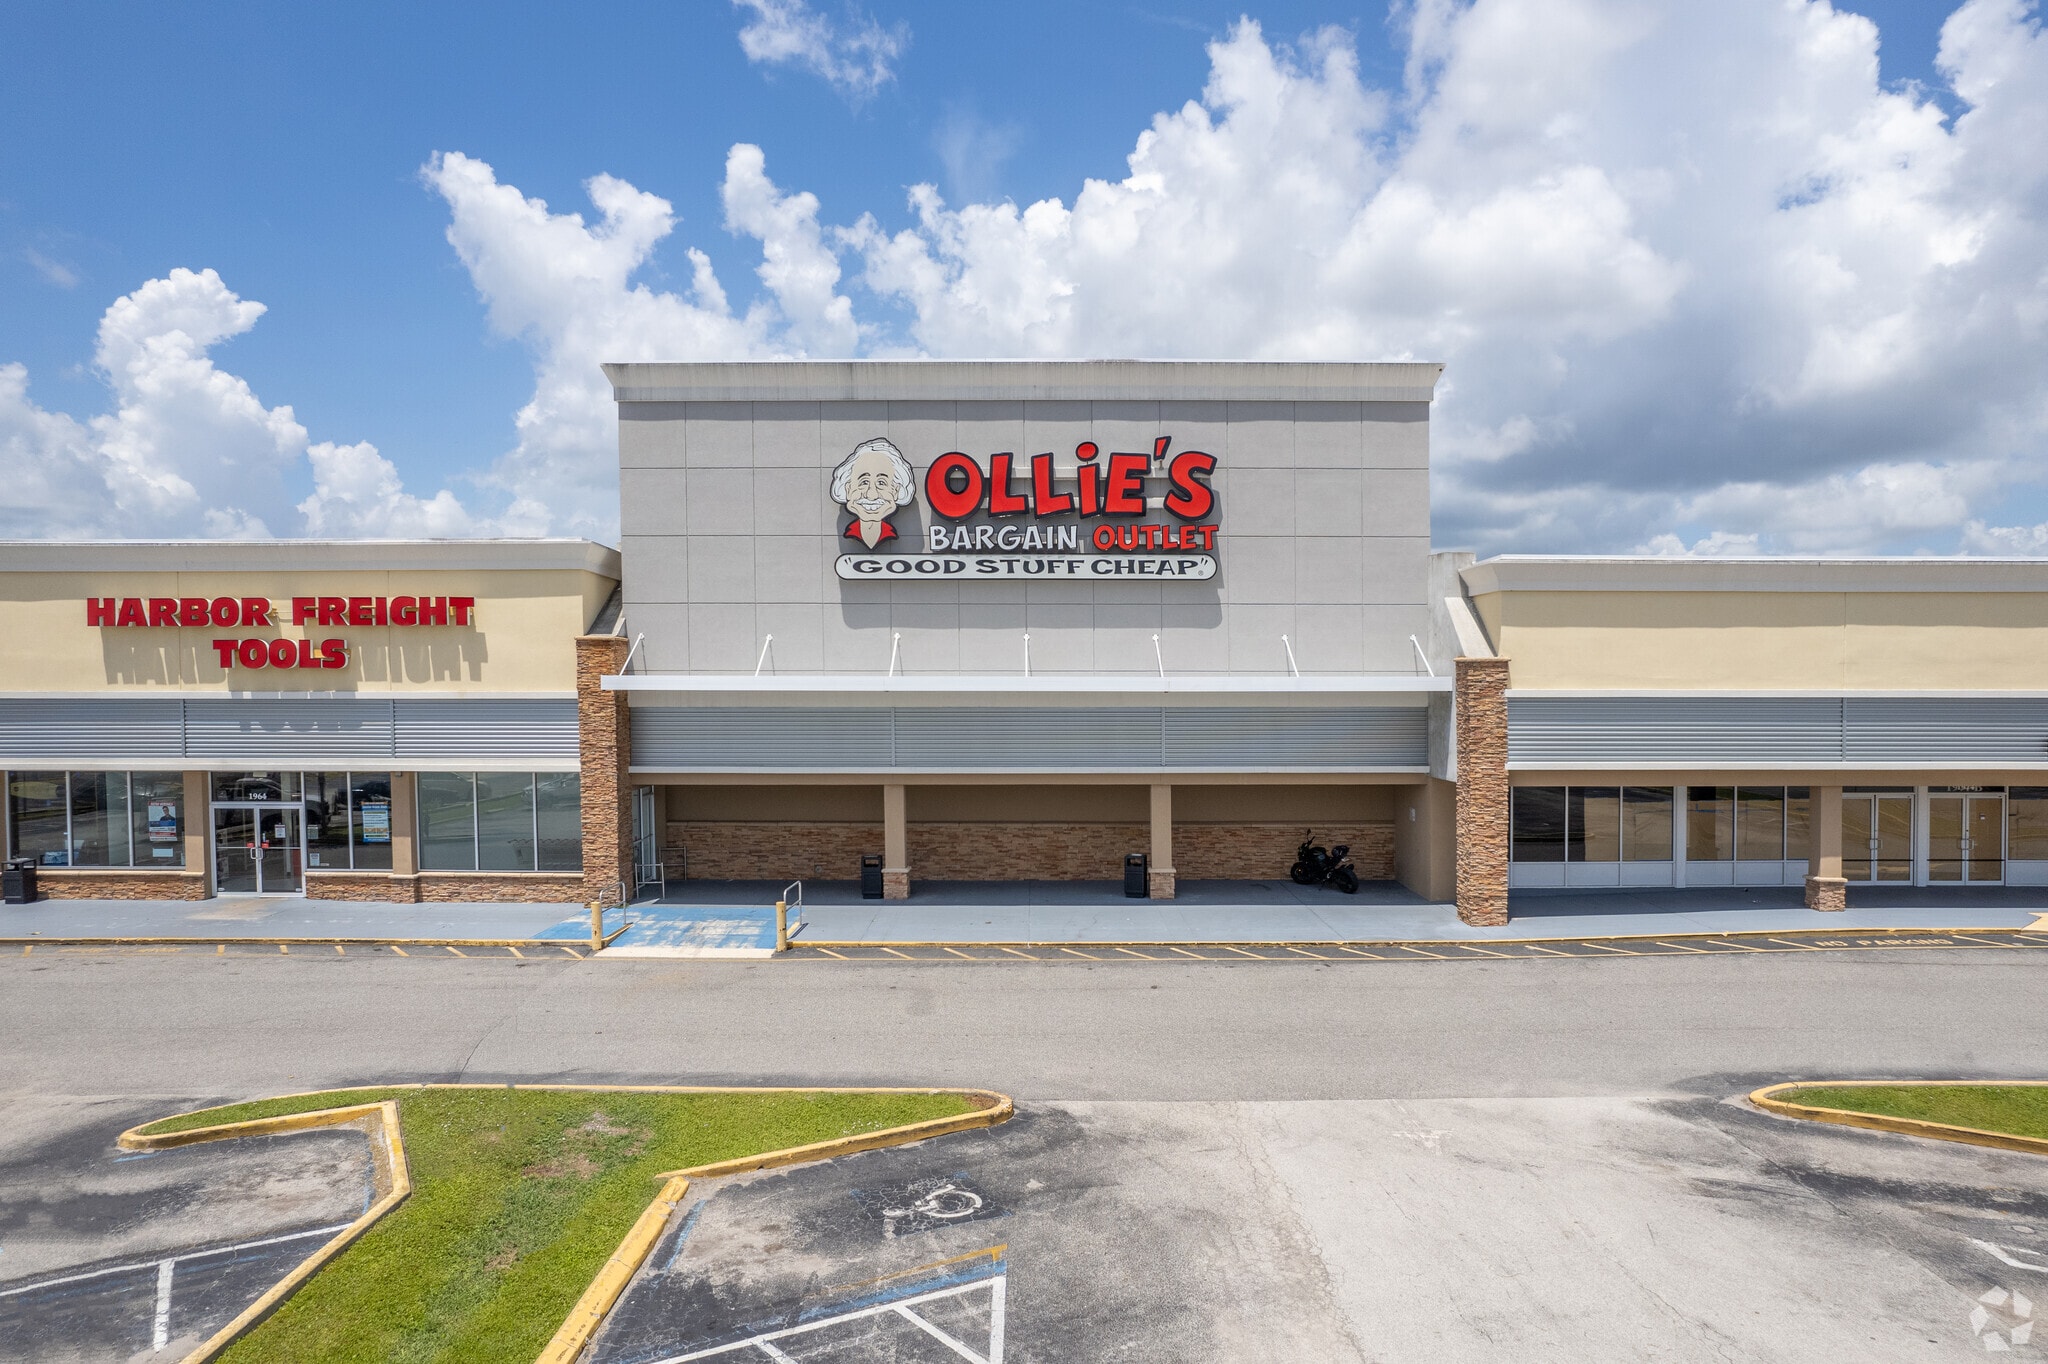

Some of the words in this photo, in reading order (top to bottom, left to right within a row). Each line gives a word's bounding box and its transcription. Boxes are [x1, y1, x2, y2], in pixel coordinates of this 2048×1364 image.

[929, 525, 1078, 551] BARGAIN
[1093, 524, 1219, 551] OUTLET
[975, 558, 1085, 575] STUFF
[87, 596, 274, 628] HARBOR
[292, 595, 475, 627] FREIGHT
[212, 638, 350, 670] TOOLS
[249, 792, 267, 800] 1964
